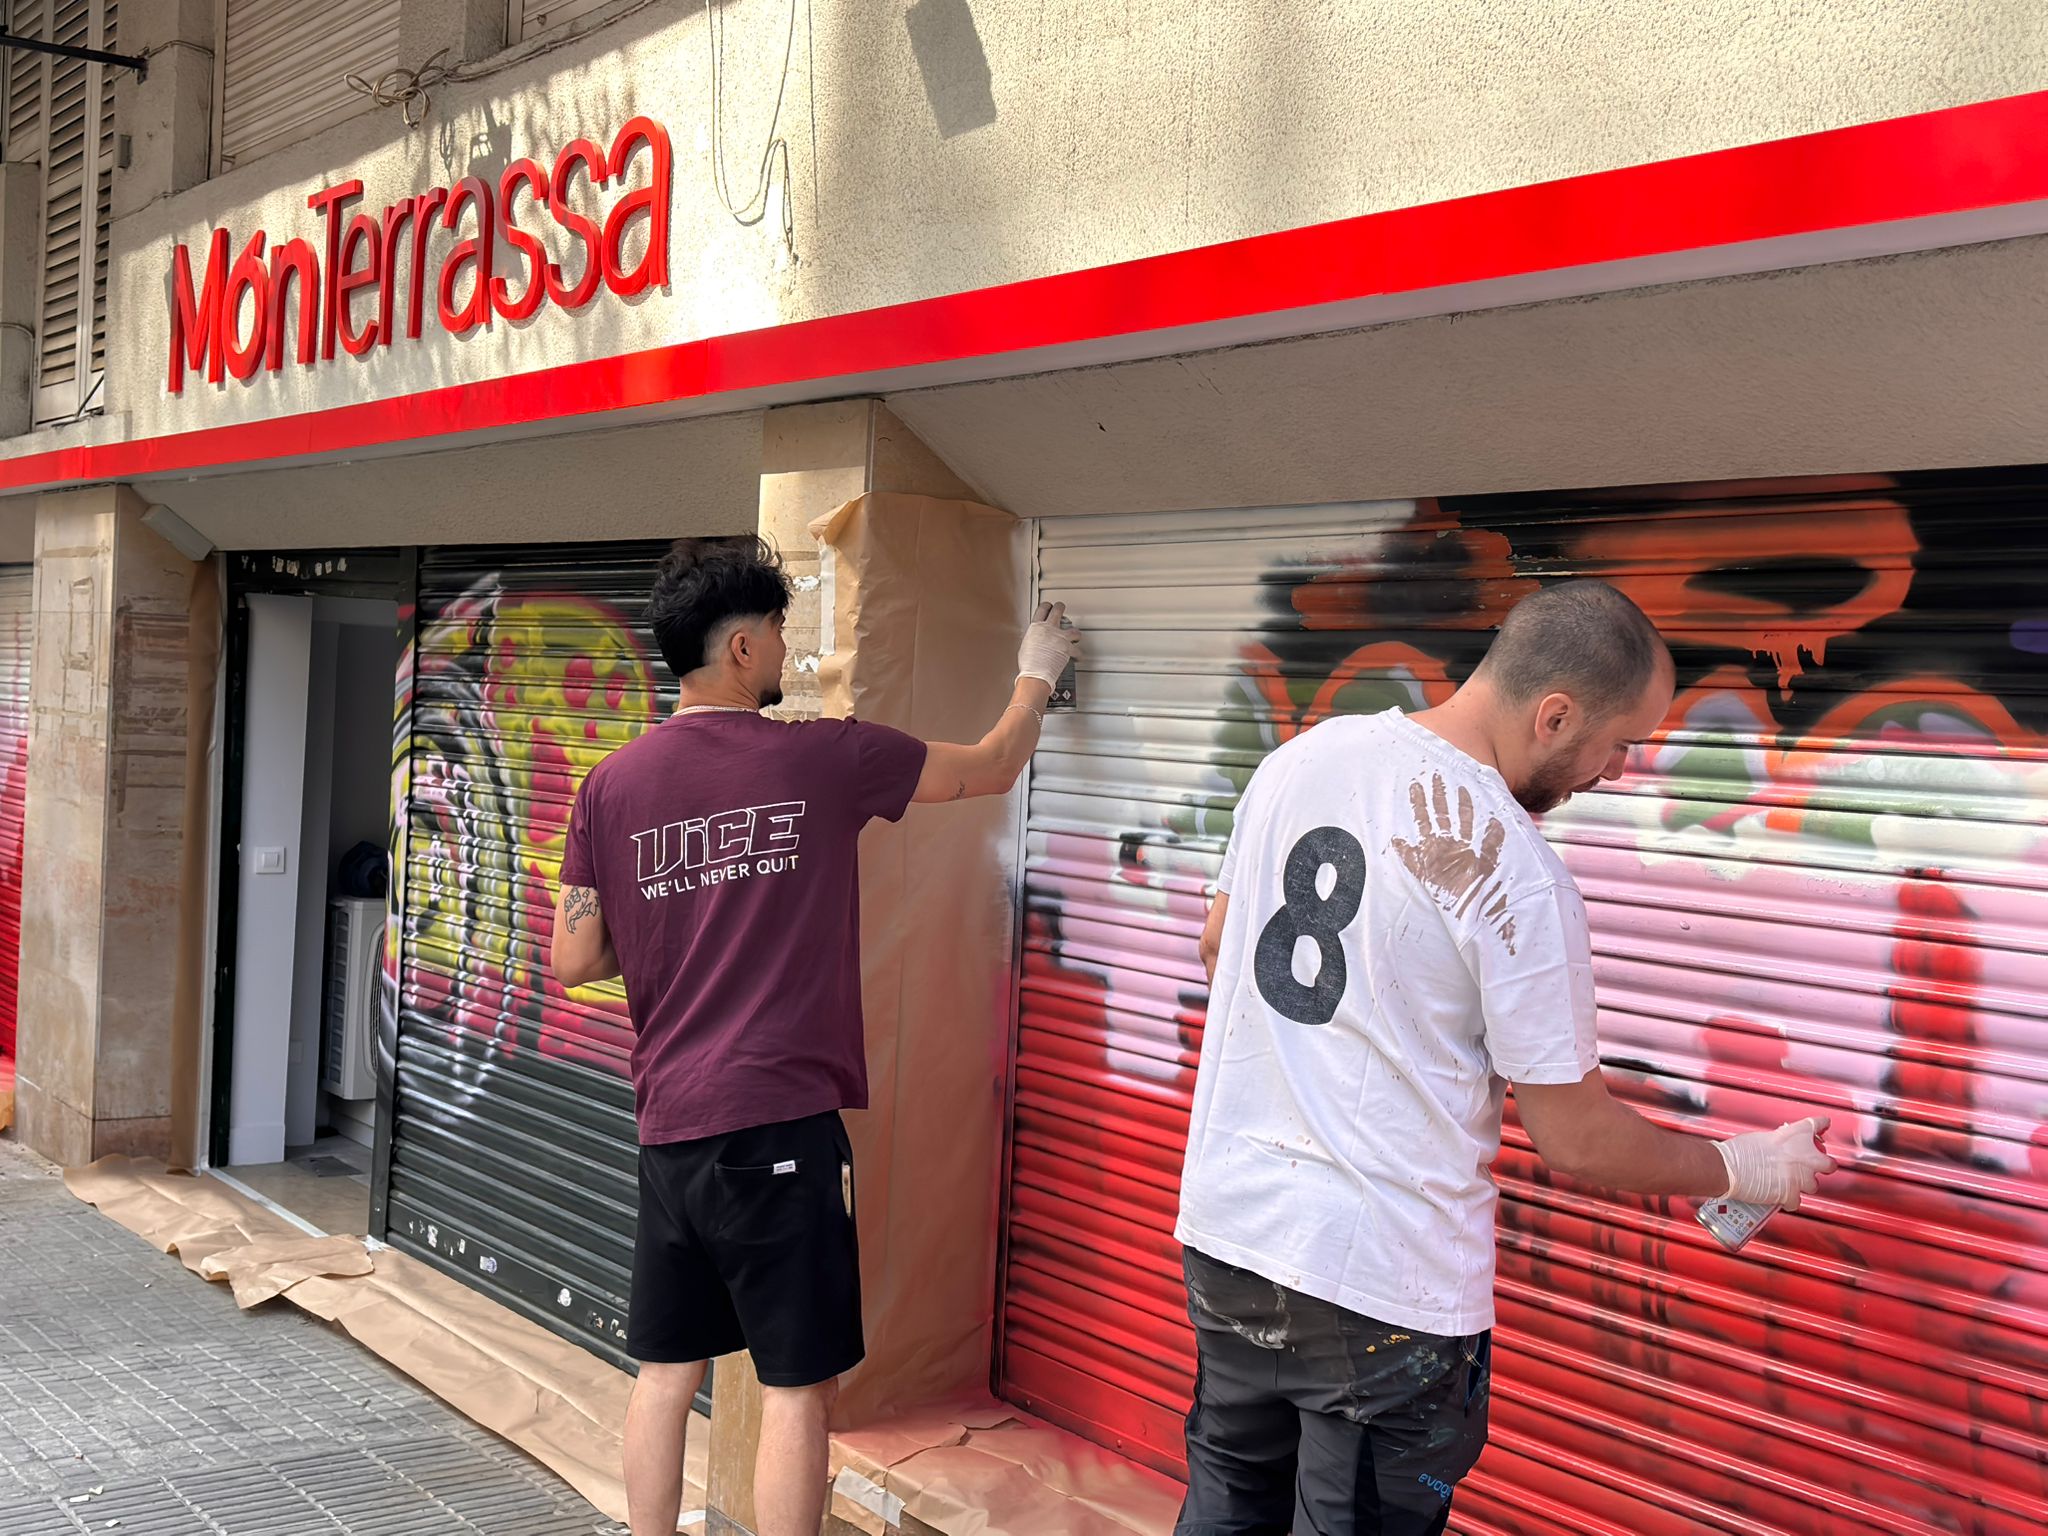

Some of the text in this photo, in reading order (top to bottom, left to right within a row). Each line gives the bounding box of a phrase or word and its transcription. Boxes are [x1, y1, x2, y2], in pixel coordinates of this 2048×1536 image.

[168, 115, 671, 393] MónTerrassa
[641, 855, 799, 901] WE'LL NEVER QUIT
[1254, 826, 1367, 1025] 8
